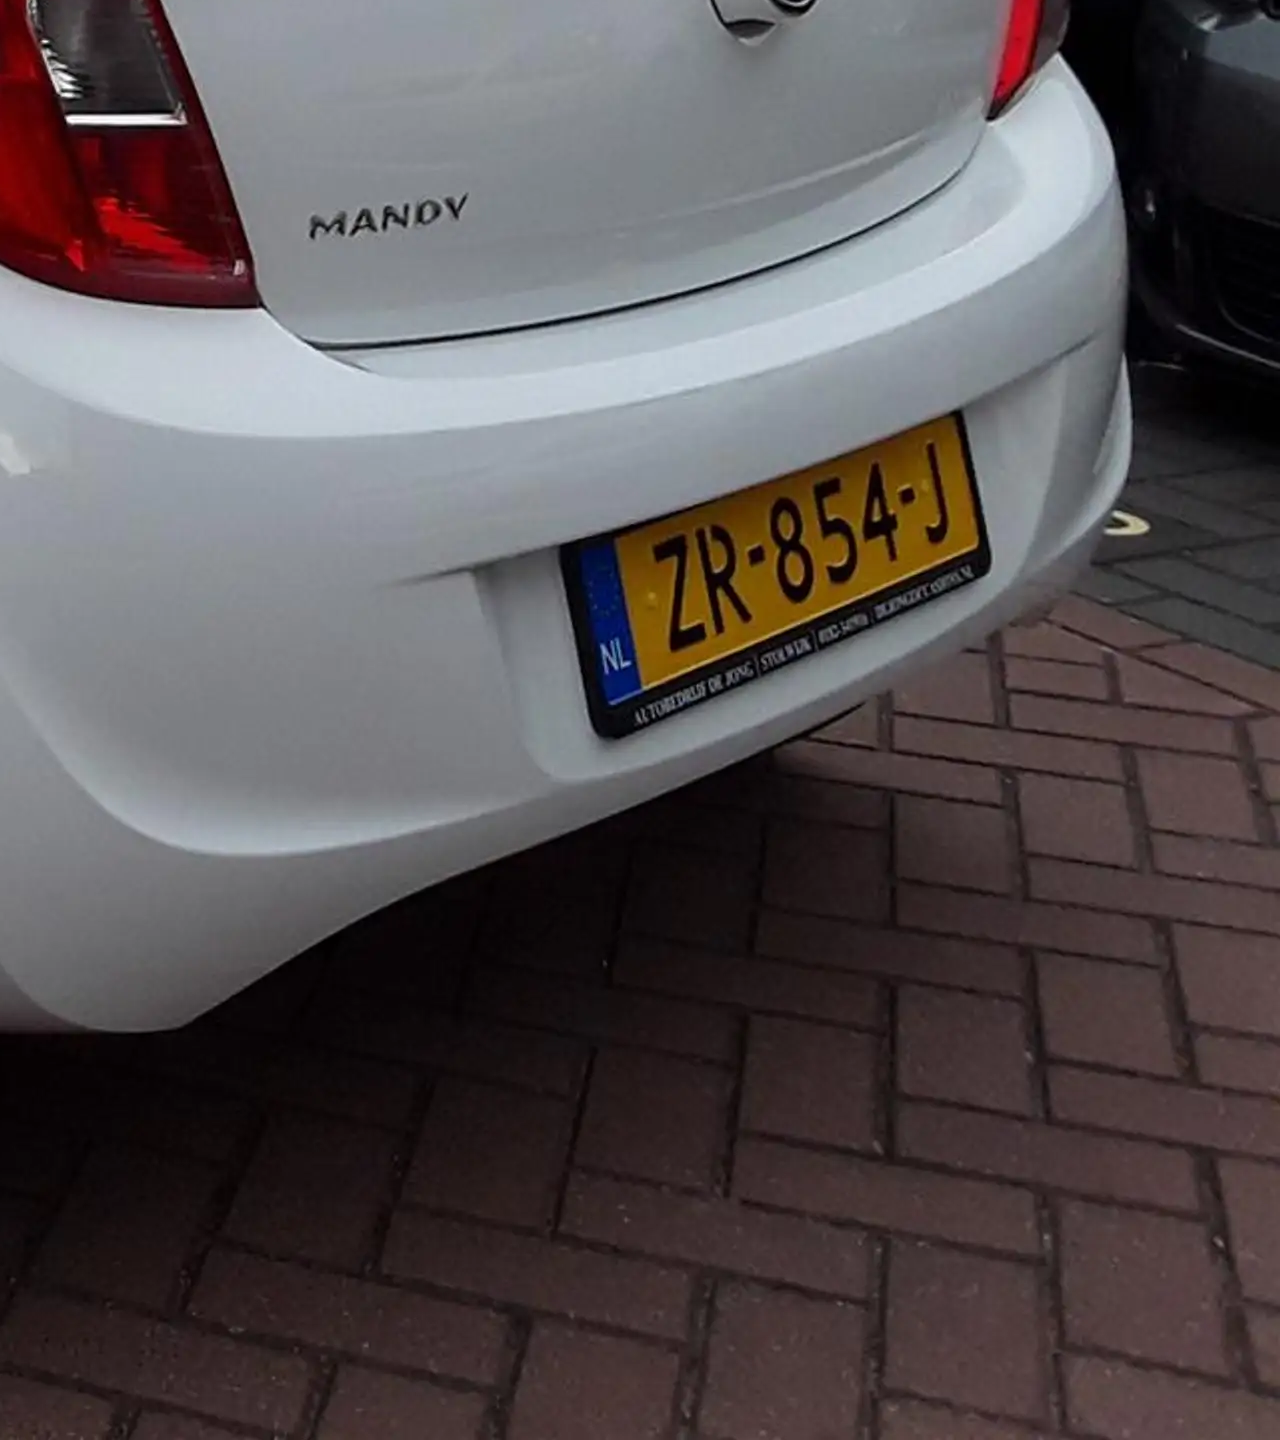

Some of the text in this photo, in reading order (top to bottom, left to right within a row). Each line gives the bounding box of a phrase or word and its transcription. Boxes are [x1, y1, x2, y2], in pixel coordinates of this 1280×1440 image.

[308, 192, 469, 240] MANDY
[652, 442, 949, 653] ZR-854-J
[600, 637, 631, 676] NL
